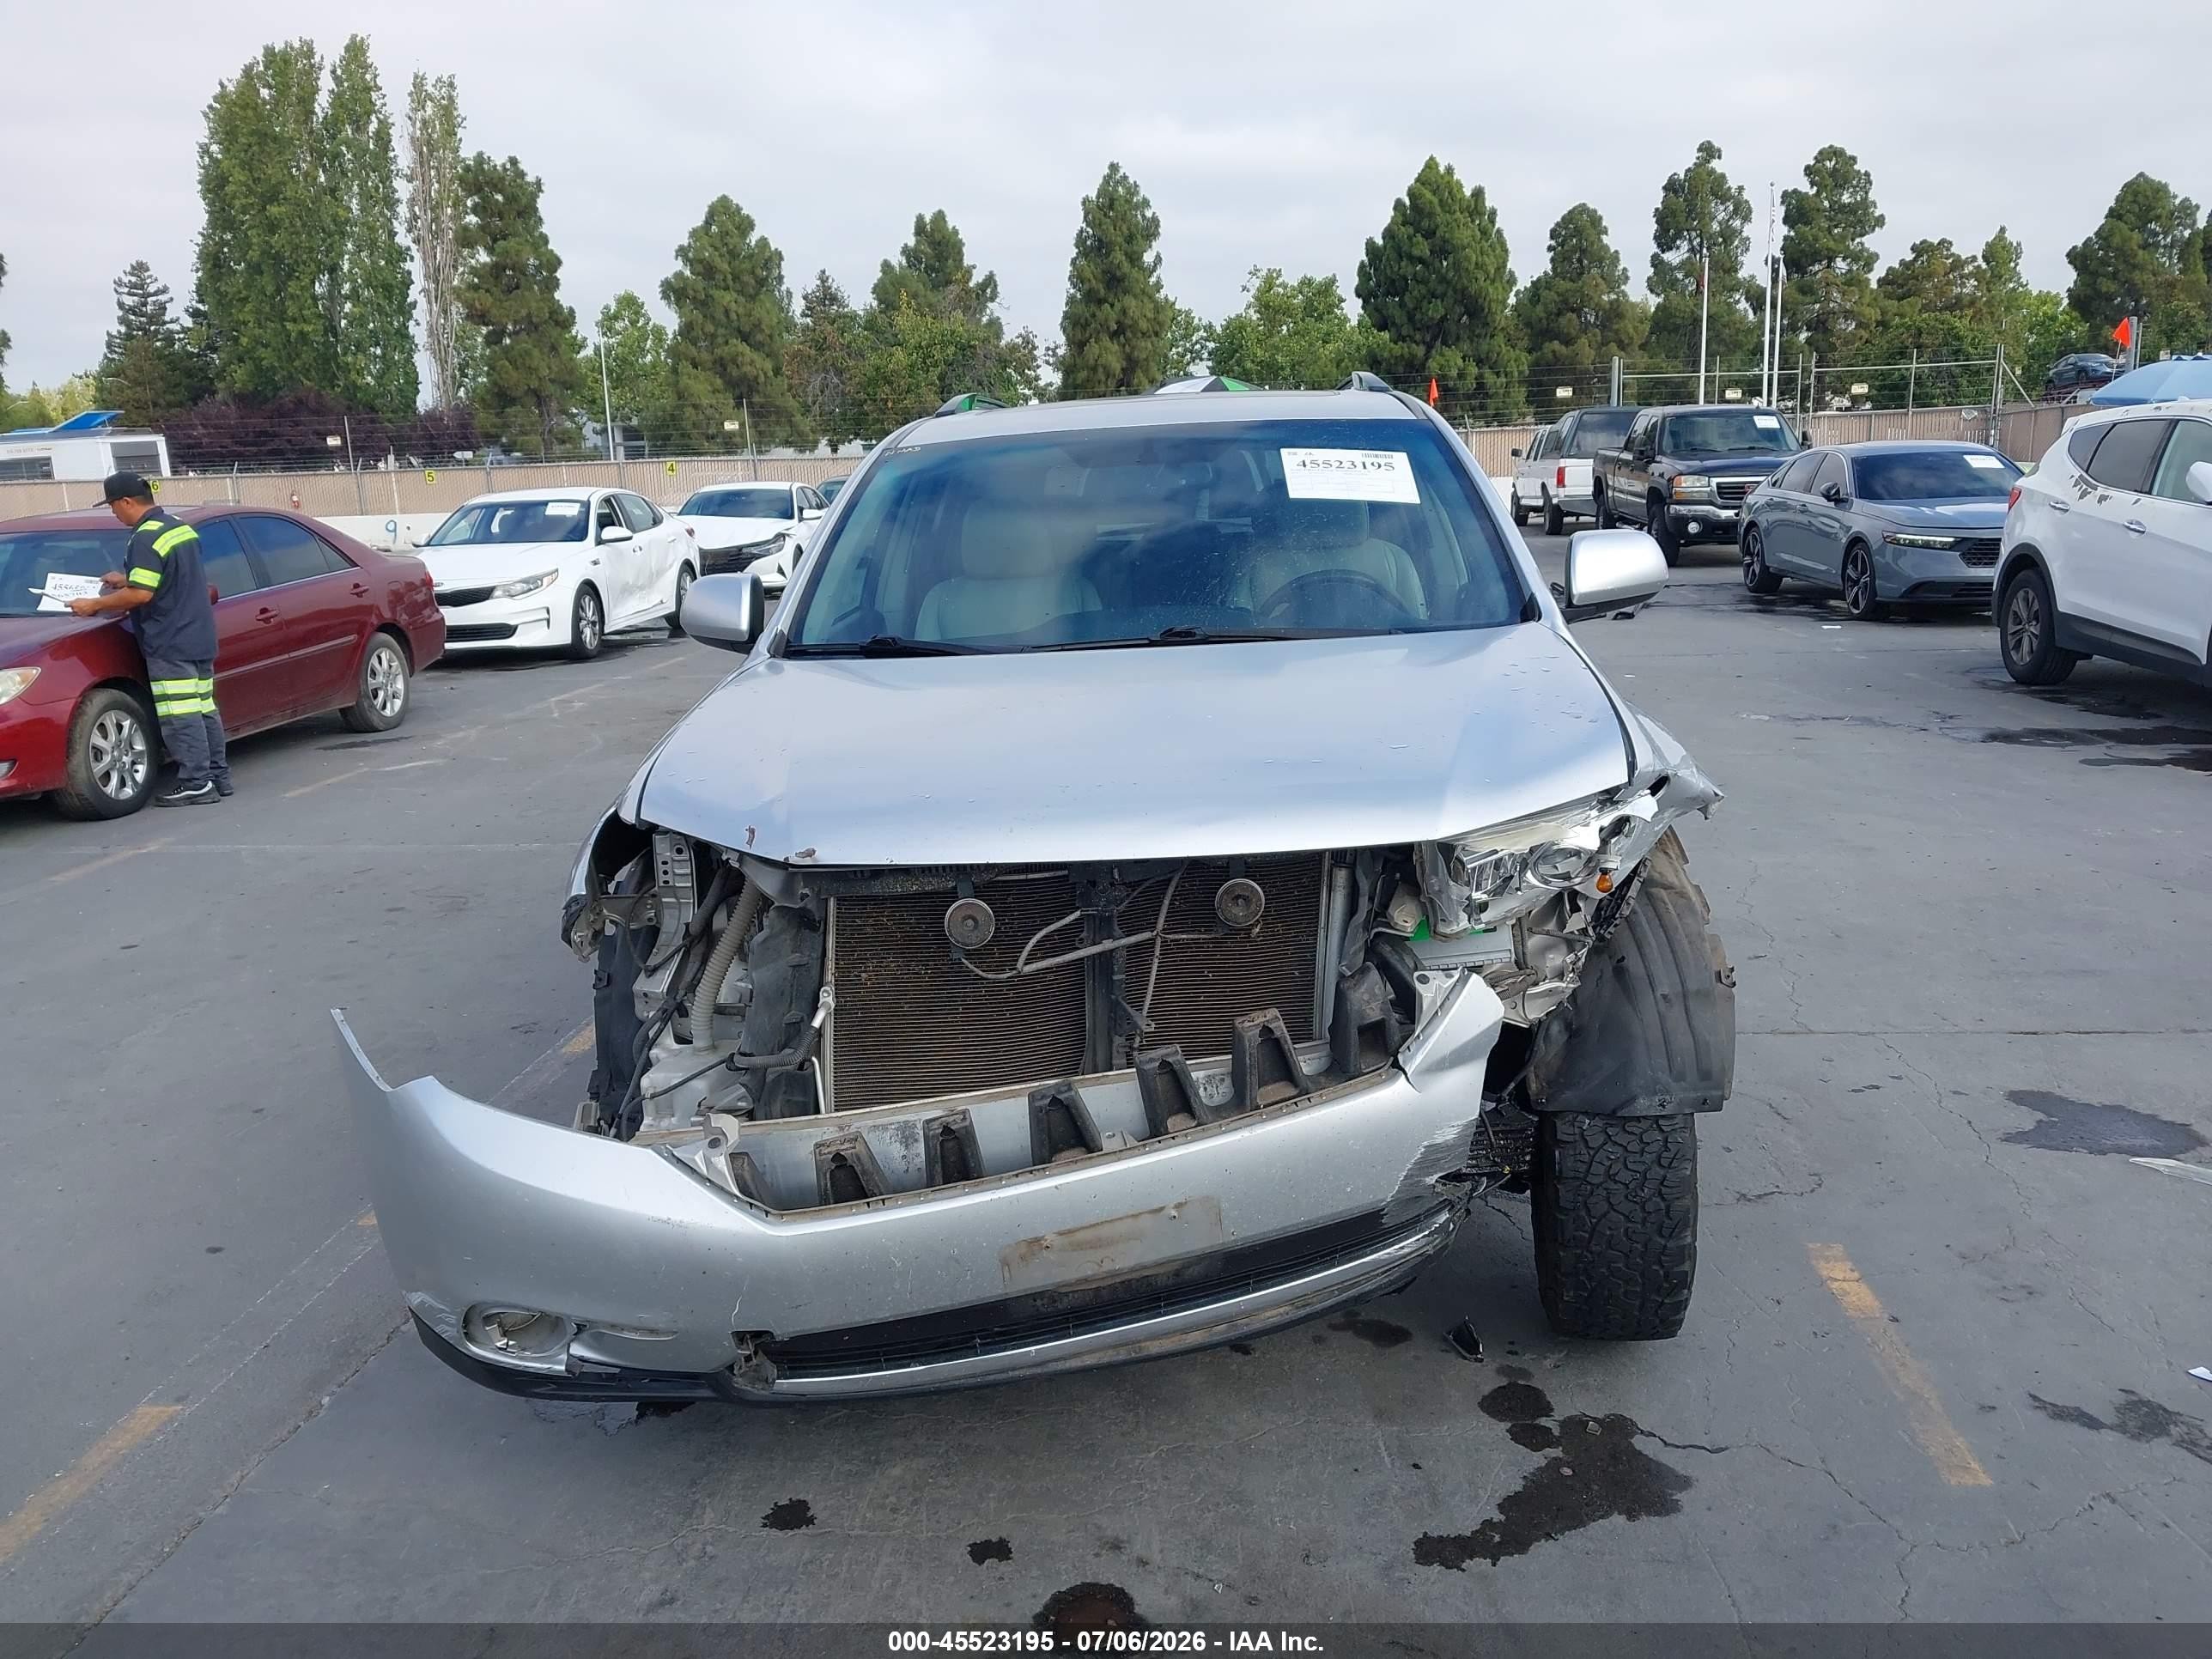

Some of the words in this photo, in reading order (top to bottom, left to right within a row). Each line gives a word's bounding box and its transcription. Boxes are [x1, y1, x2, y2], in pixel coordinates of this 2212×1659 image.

[667, 462, 675, 473] 4
[1297, 459, 1395, 471] 45523195
[427, 471, 434, 483] 5
[151, 480, 159, 491] 6
